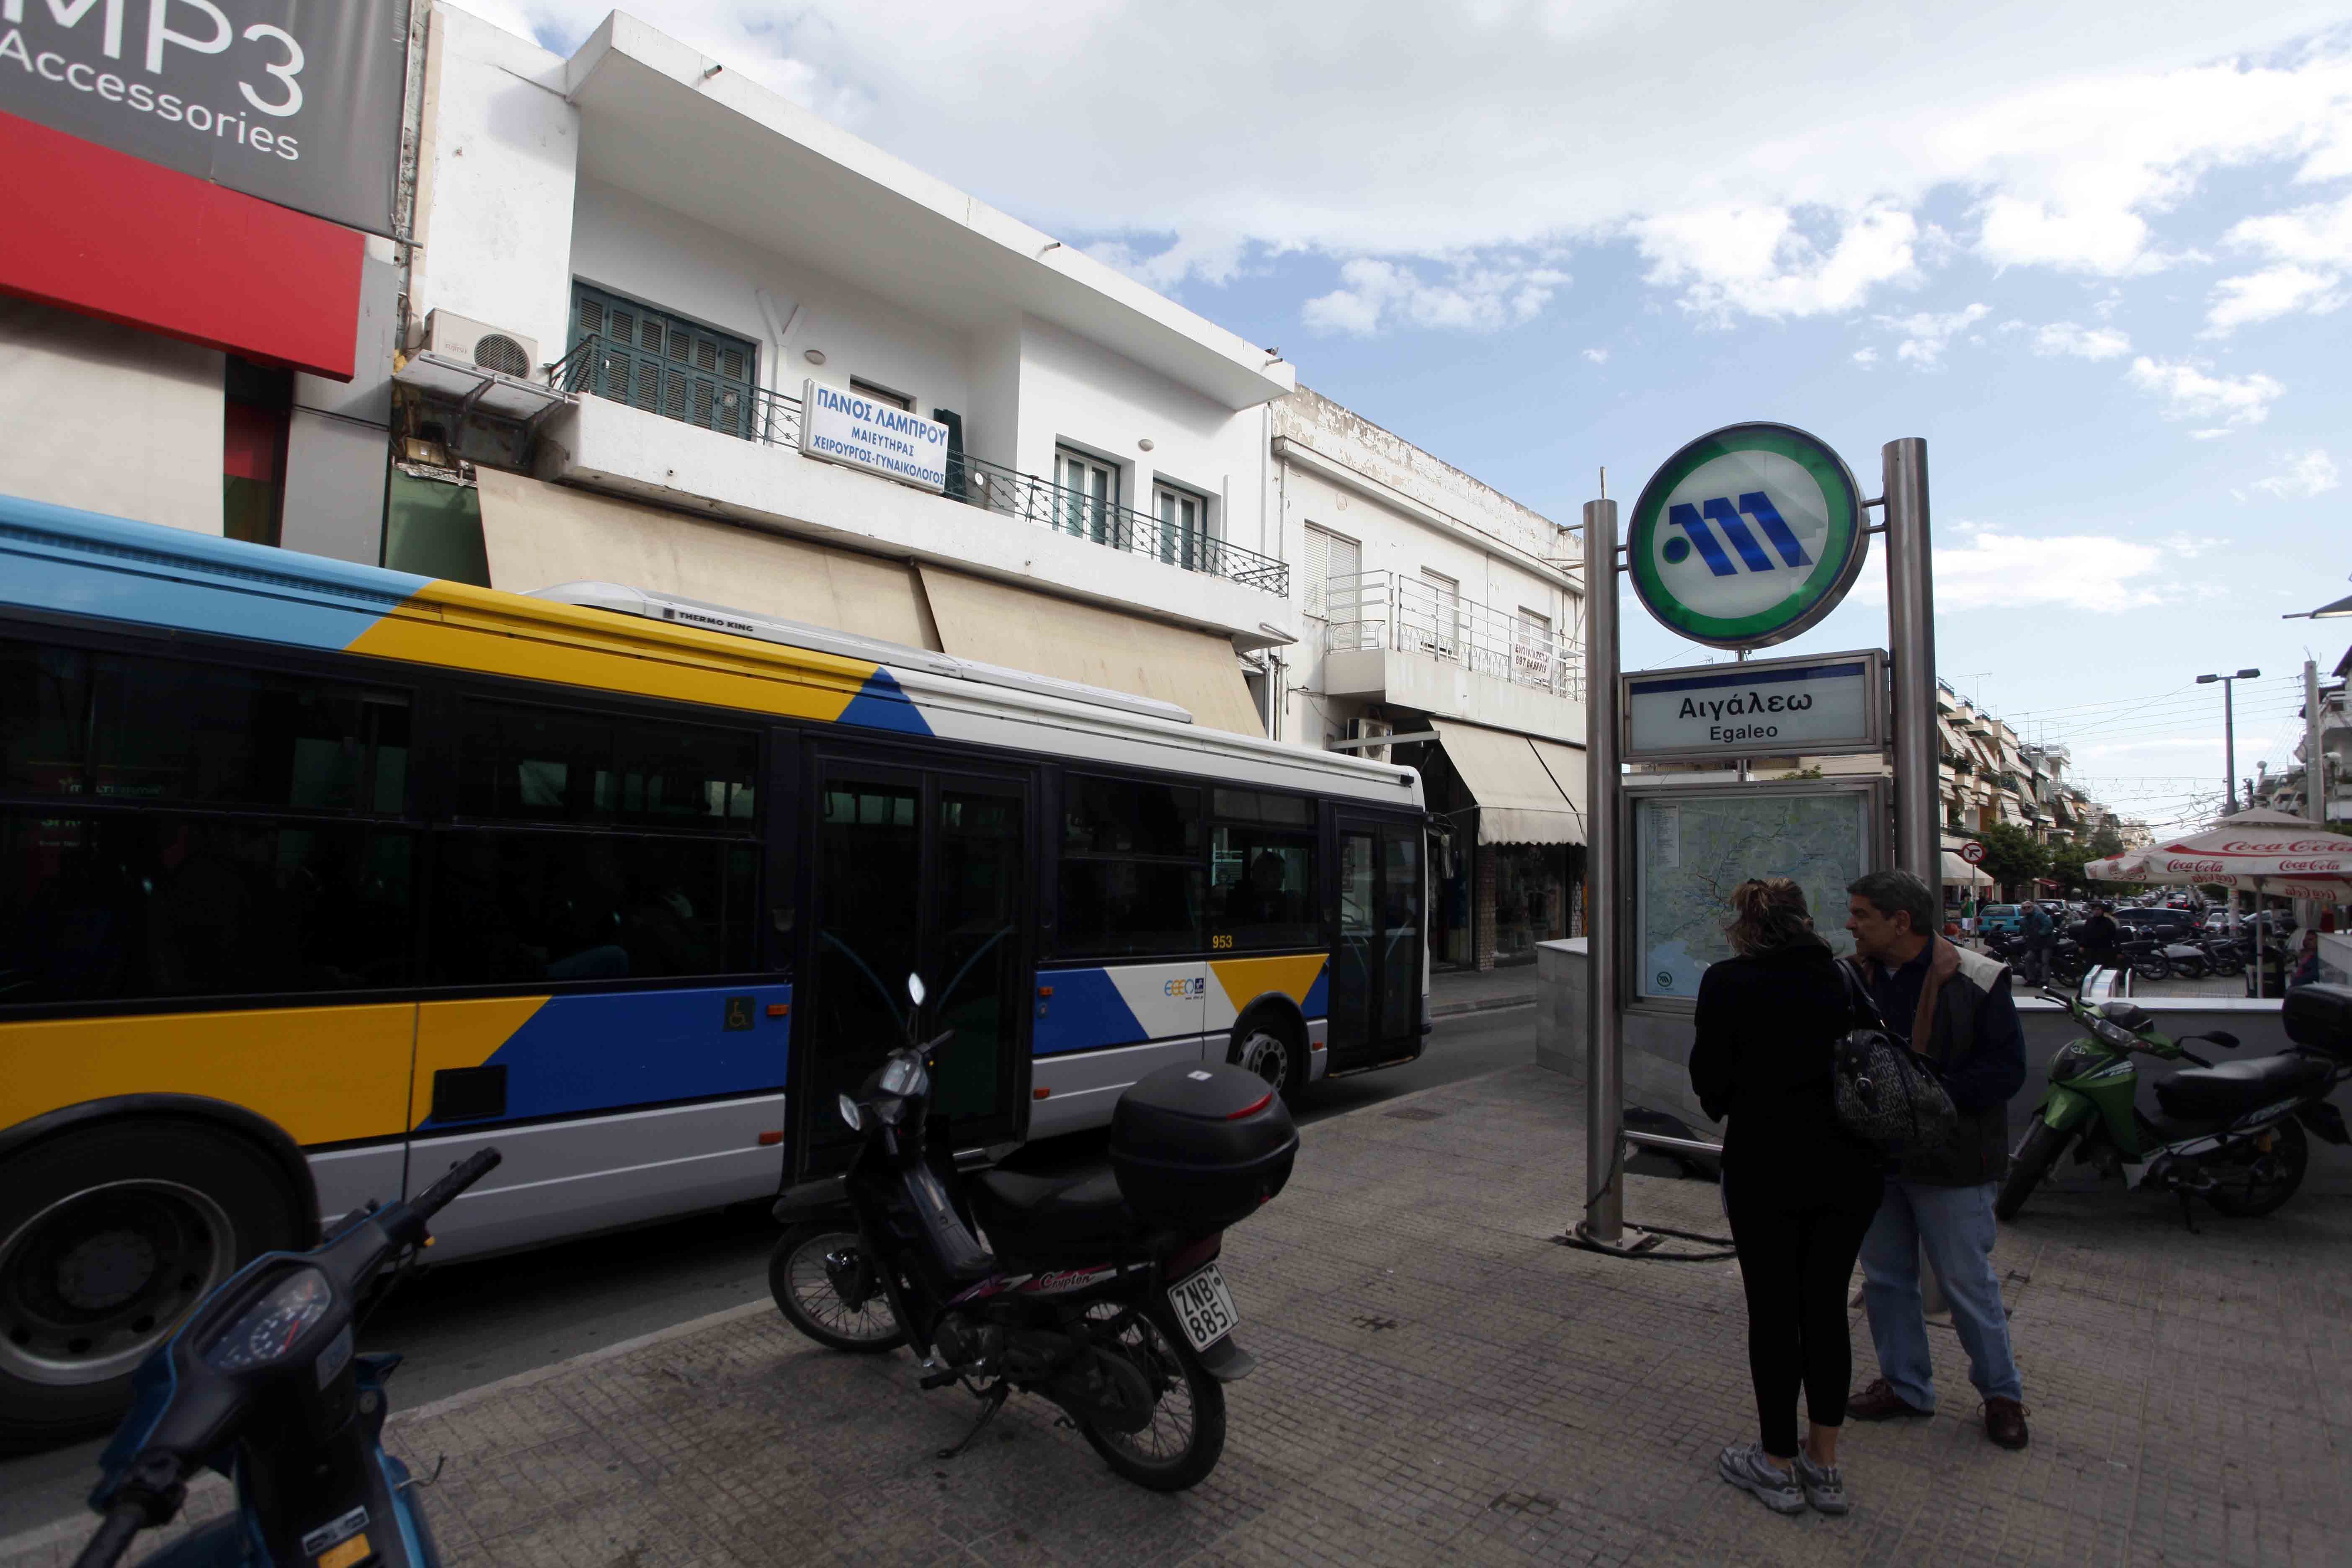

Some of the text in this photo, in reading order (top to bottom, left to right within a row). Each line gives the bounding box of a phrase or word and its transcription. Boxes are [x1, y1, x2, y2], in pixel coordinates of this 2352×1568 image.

[0, 28, 299, 160] Accessories
[817, 388, 947, 446] ΠΑΝΟΣ ΛΑΜΠΡΟΥ
[851, 426, 914, 456] ΜΑΙΕΥΤΗΡΑΣ
[679, 611, 754, 632] THERMO KING
[1679, 692, 1813, 721] Αιγάλεω
[1710, 725, 1778, 743] Egaleo
[1212, 935, 1233, 949] 953
[1040, 1271, 1094, 1290] Crypton
[1175, 1277, 1213, 1317] ZNB
[1189, 1302, 1228, 1343] 885
